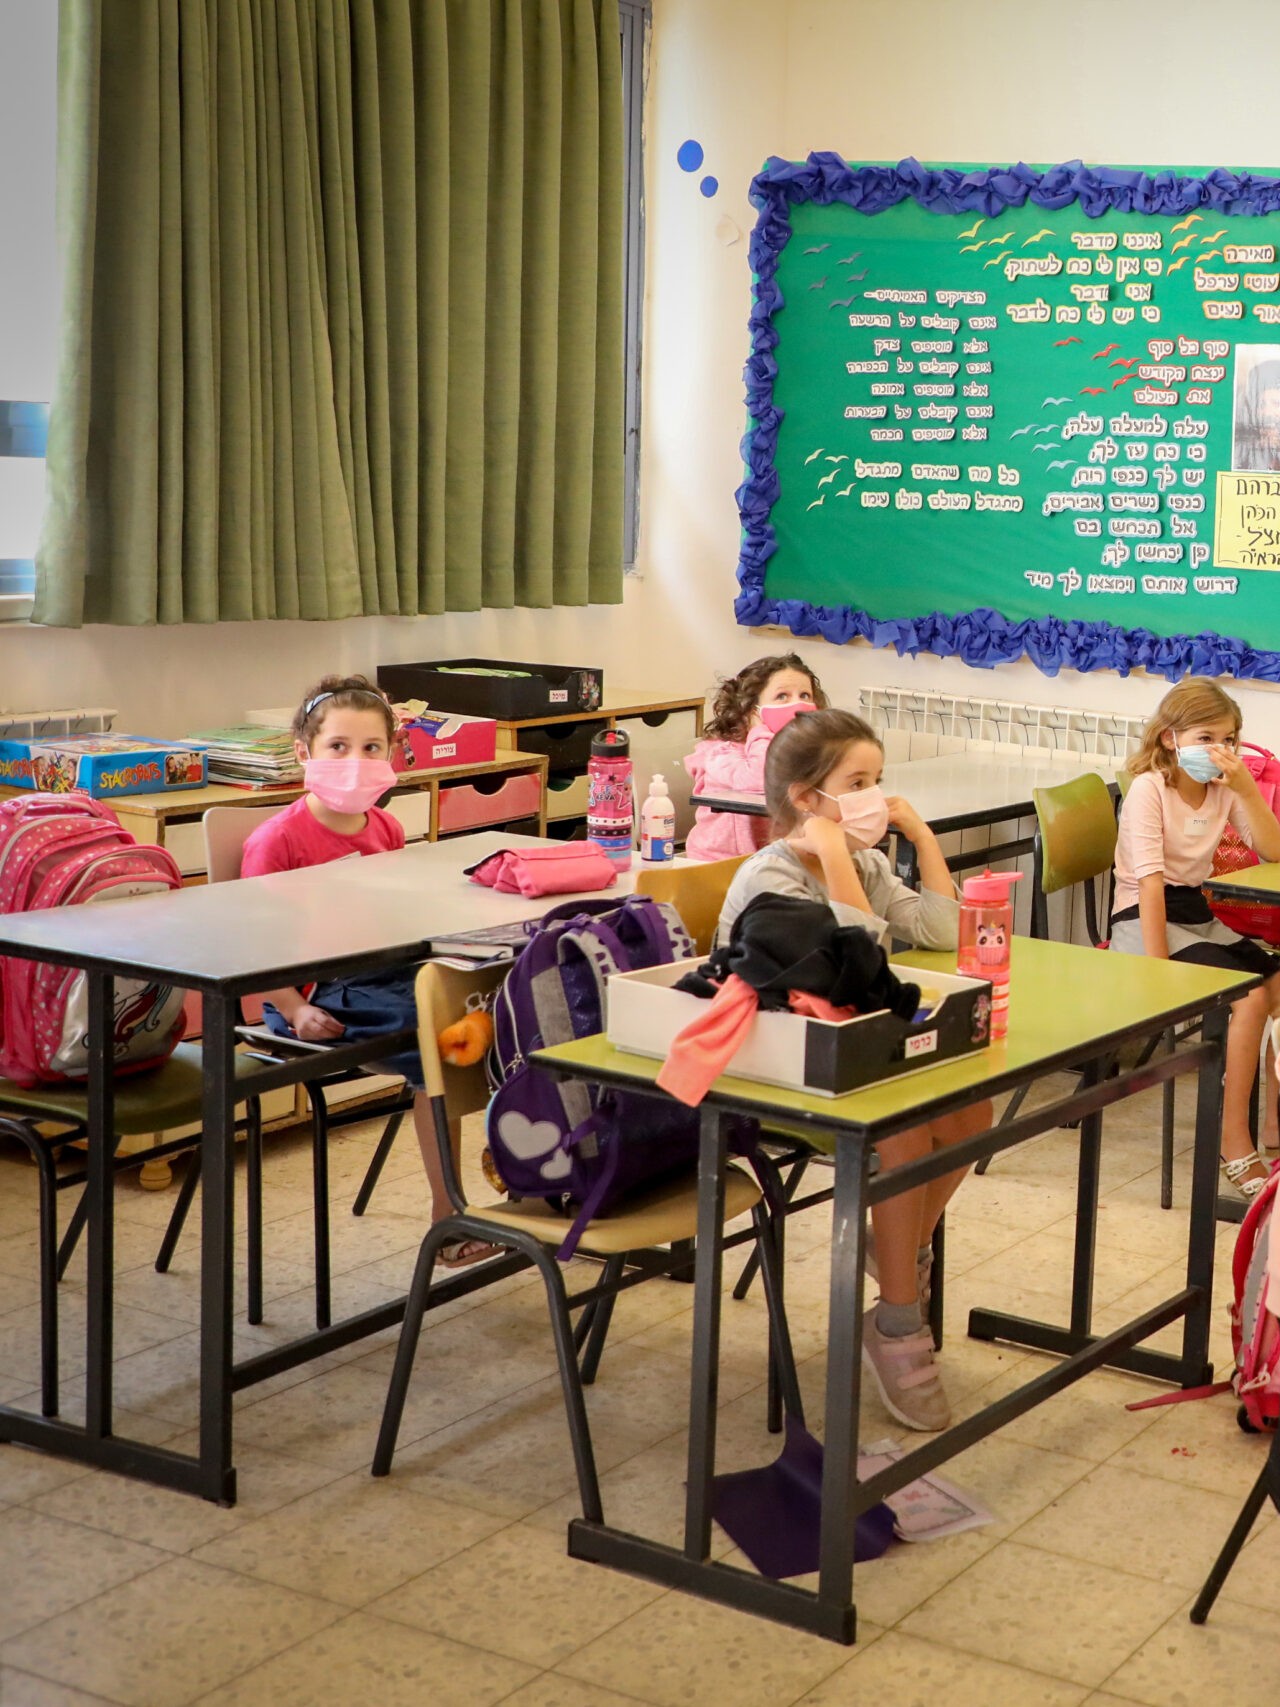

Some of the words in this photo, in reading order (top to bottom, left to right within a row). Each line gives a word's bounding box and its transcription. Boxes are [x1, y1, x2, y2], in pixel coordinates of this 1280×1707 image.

[1073, 235, 1115, 248] מדבר
[1126, 234, 1159, 248] אינני
[1223, 247, 1273, 261] מאירה
[1006, 255, 1059, 278] לשתוק.
[1068, 260, 1090, 273] כח
[1097, 255, 1111, 273] לי
[1118, 260, 1138, 279] אין
[1145, 261, 1160, 273] כי
[1197, 270, 1238, 289] ערפל
[1244, 277, 1277, 290] עוטי
[937, 292, 985, 306] הצדיקים
[1129, 286, 1150, 299] אני
[1008, 301, 1048, 319] לדבר
[1057, 308, 1079, 321] כח
[1089, 305, 1103, 321] לי
[1114, 309, 1132, 322] יש
[1143, 308, 1158, 320] כי
[1206, 304, 1241, 316] נעים
[851, 315, 890, 325] הרשעה
[900, 313, 915, 326] על
[922, 316, 959, 332] קובלים
[970, 318, 996, 328] אינם
[875, 340, 899, 354] צדק
[912, 341, 952, 352] מוסיפים
[965, 341, 987, 352] אלא
[1149, 342, 1172, 359] סוף
[1179, 337, 1199, 353] כל
[1204, 342, 1227, 359] סוף
[848, 362, 888, 372] הכפירה
[898, 359, 913, 372] על
[921, 360, 958, 375] קובלים
[967, 362, 991, 373] אינם
[1140, 366, 1184, 384] הקודש
[1192, 367, 1223, 379] ינצח
[872, 384, 904, 394] אמונה
[914, 385, 953, 395] מוסיפים
[964, 383, 987, 395] אלא
[1136, 387, 1176, 402] העולם
[1188, 391, 1209, 402] את
[896, 406, 911, 418] על
[919, 404, 957, 421] קובלים
[967, 407, 991, 417] אינם
[1065, 415, 1100, 436] עלה,
[1112, 414, 1164, 433] למעלה
[1175, 418, 1206, 436] עלה
[872, 430, 902, 439] חכמה
[913, 429, 953, 440] מוסיפים
[963, 426, 986, 439] אלא
[1127, 445, 1145, 458] עז
[1156, 446, 1177, 459] כח
[1189, 446, 1203, 458] כי
[856, 461, 900, 476] מתגדל
[914, 466, 958, 478] שהאדם
[970, 468, 989, 480] מה
[1000, 467, 1017, 483] כל
[1113, 470, 1145, 483] כנפי
[1155, 465, 1174, 489] לך
[1185, 471, 1203, 483] יש
[864, 494, 888, 505] עימו
[897, 490, 920, 506] כולו
[930, 492, 969, 507] העולם
[977, 493, 1021, 509] מתגדל
[1111, 495, 1156, 508] נשרים
[1170, 497, 1202, 510] כנפי
[1241, 504, 1276, 528] הכהן
[1138, 546, 1180, 558] יכחשו
[1192, 545, 1207, 565] פן
[1027, 573, 1051, 586] מיד
[1060, 570, 1079, 593] לך
[1089, 577, 1133, 590] וימצאו
[1144, 578, 1183, 592] אותם
[1196, 579, 1235, 591] דרוש
[100, 762, 162, 790] STACROBATS
[910, 1036, 931, 1050] כרמי
